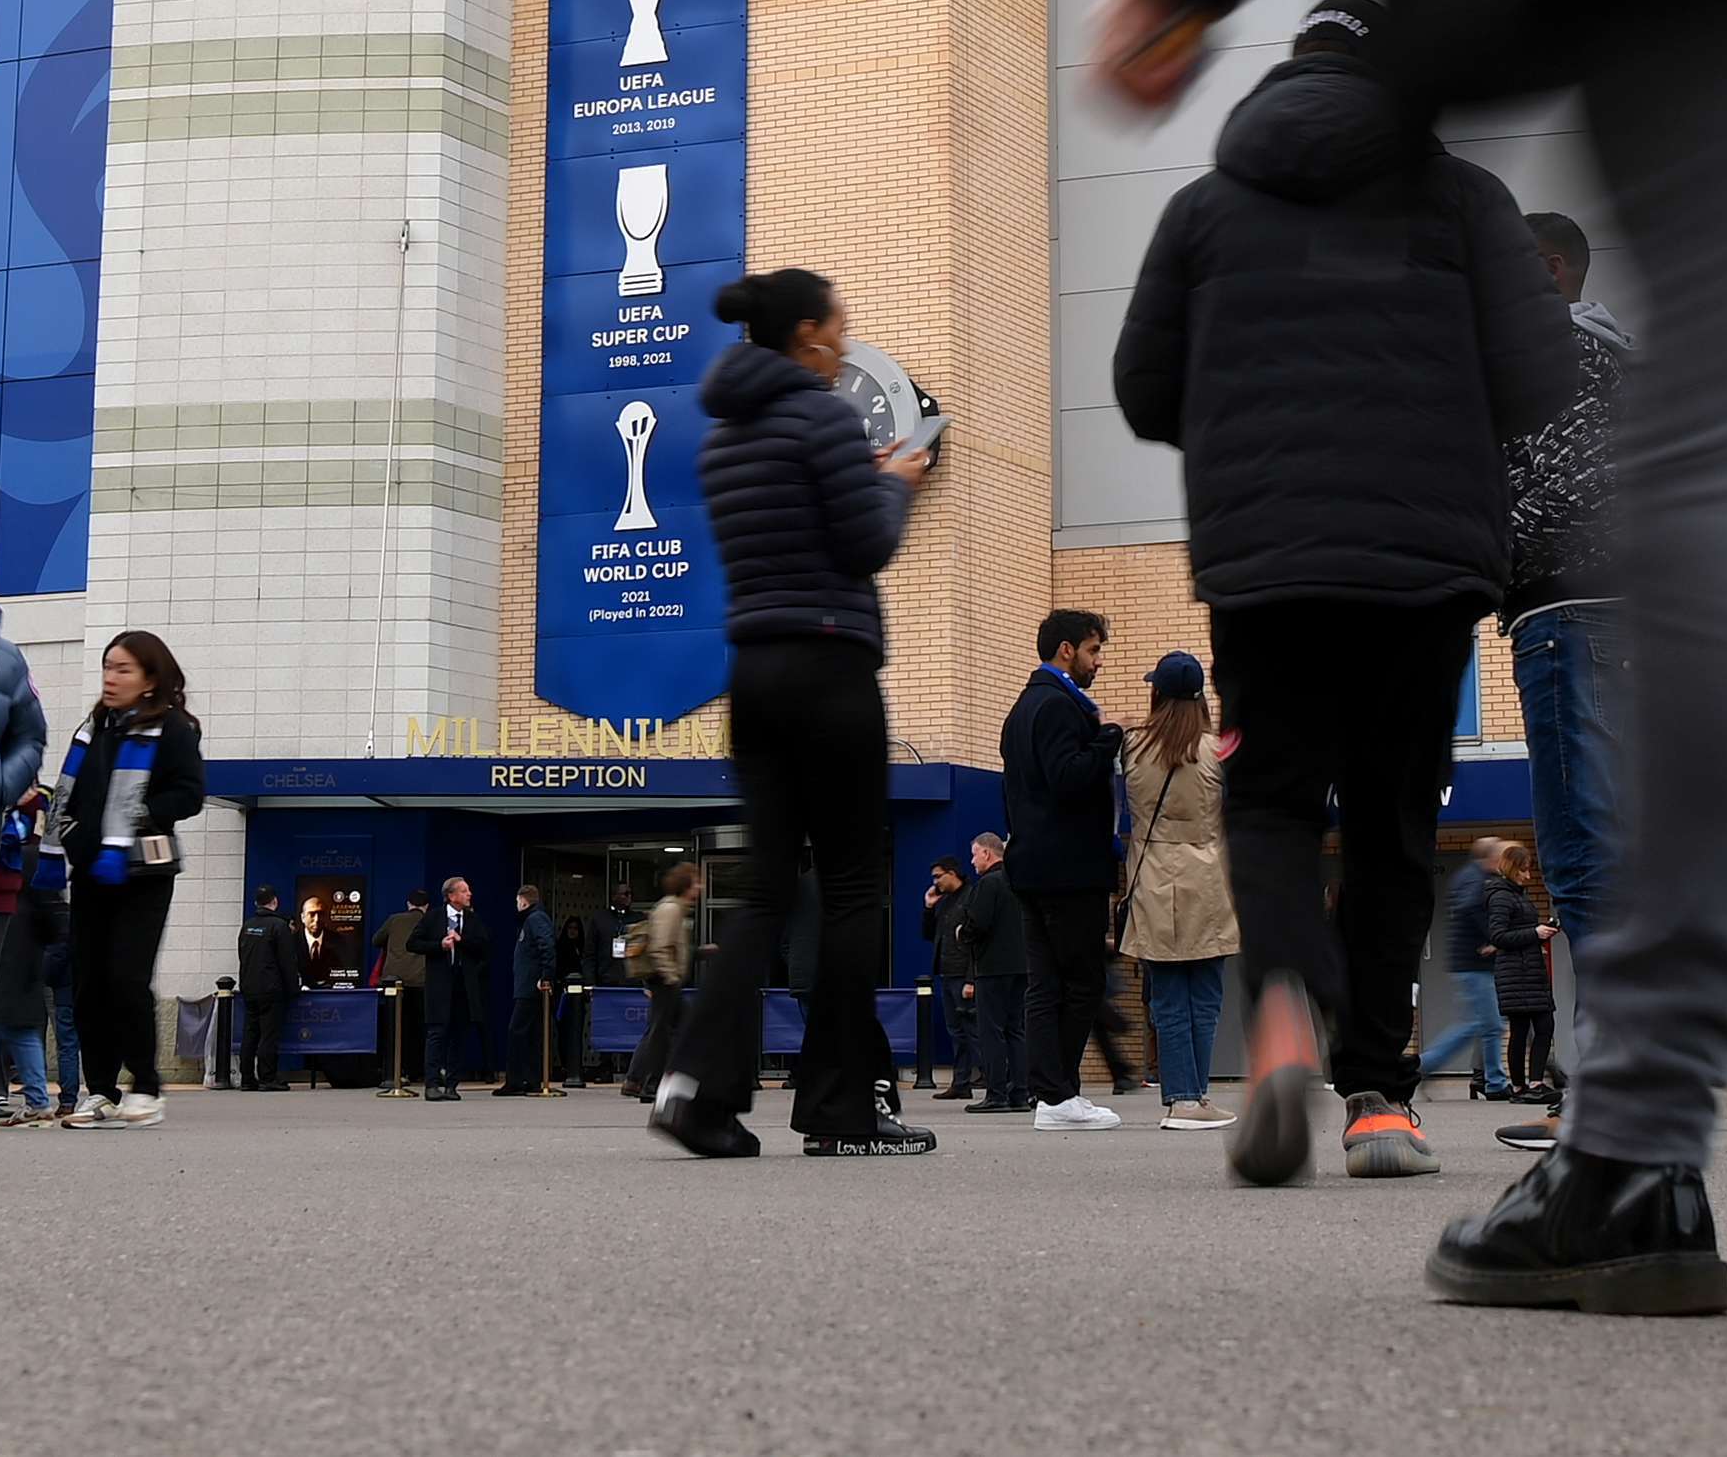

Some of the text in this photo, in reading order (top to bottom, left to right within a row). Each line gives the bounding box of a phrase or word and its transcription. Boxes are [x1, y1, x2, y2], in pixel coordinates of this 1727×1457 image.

[619, 72, 664, 91] UEFA
[574, 88, 715, 118] EUROPA LEAGUE
[612, 118, 675, 135] 2013, 2019
[618, 305, 663, 323] UEFA
[592, 324, 689, 347] SUPER CUP
[609, 352, 672, 368] 1998, 2021
[872, 395, 886, 413] 2
[592, 539, 682, 560] FIFA CLUB
[584, 562, 689, 583] WORLD CUP
[621, 591, 650, 603] 2021
[589, 604, 683, 622] (Played in 2022)
[407, 717, 731, 757] MILLENNIUM
[262, 774, 336, 788] CHELSEA
[491, 766, 646, 788] RECEPTION
[837, 1140, 866, 1155] Love
